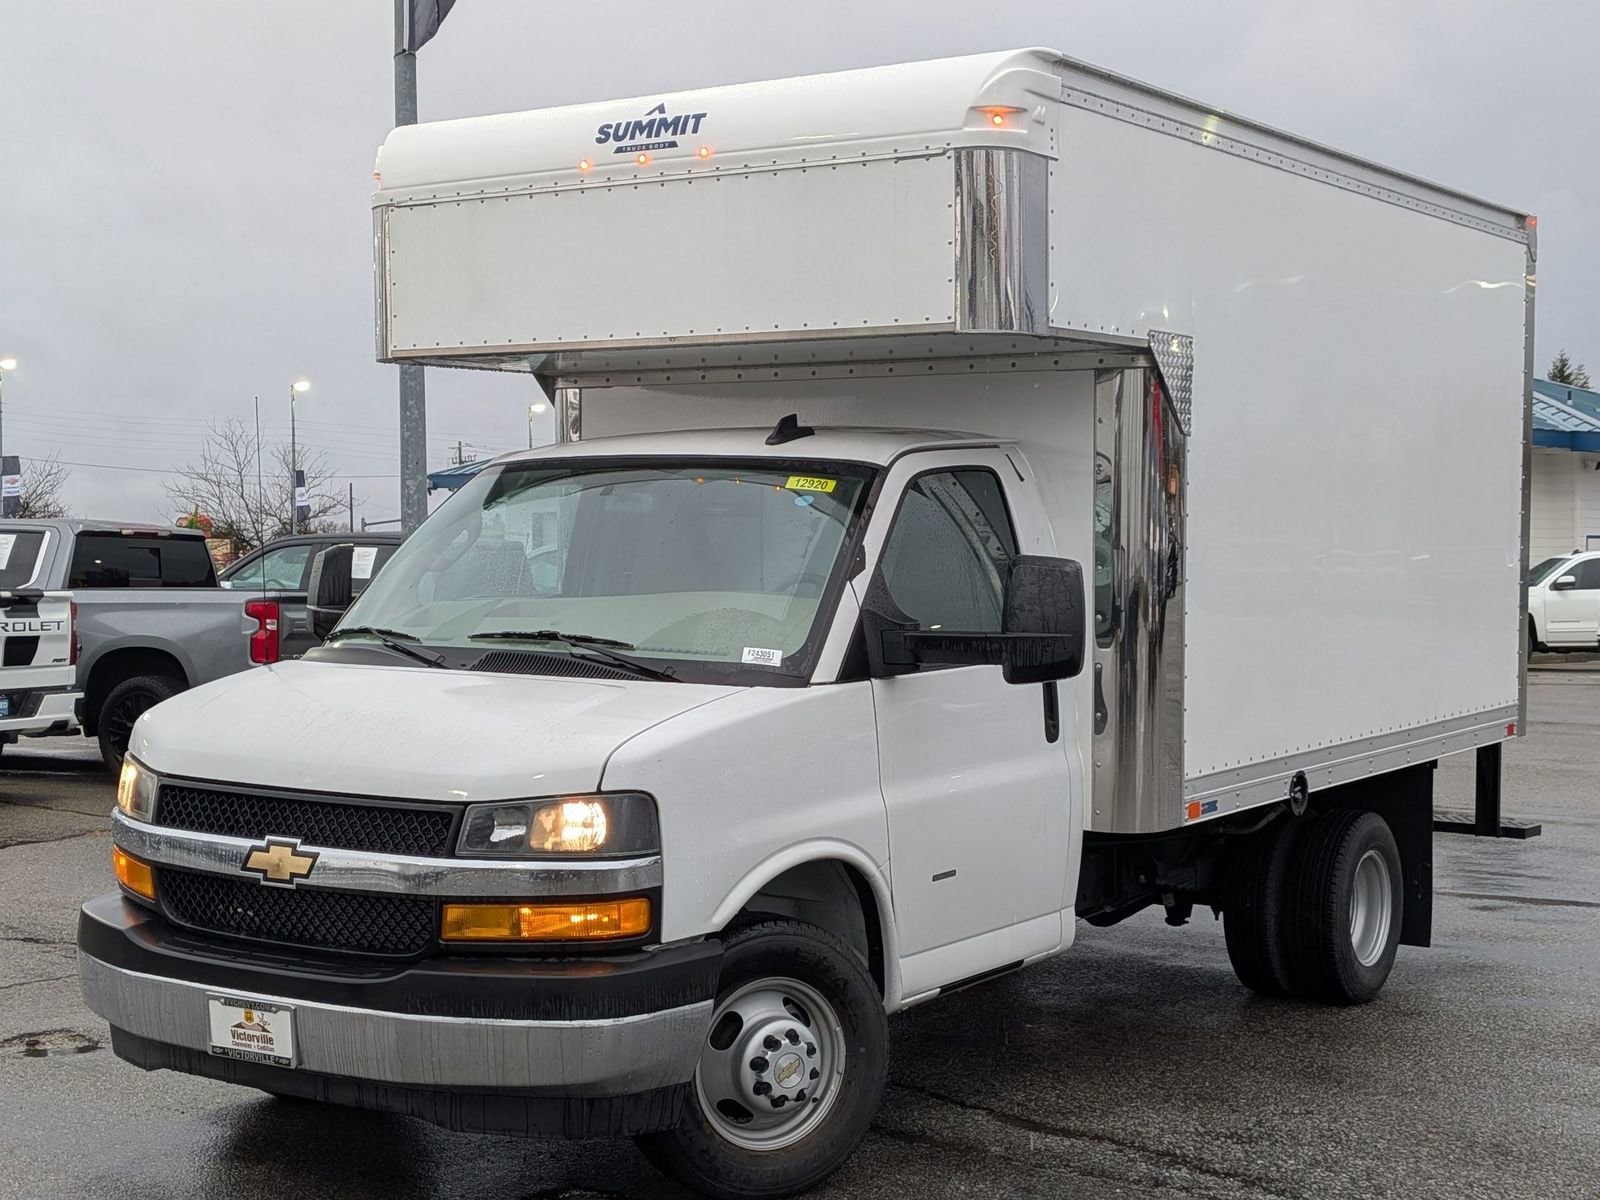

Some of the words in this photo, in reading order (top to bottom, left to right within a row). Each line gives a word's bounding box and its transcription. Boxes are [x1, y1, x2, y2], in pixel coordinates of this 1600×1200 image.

[595, 112, 707, 145] SUMMIT
[795, 478, 829, 490] 12920
[748, 649, 775, 659] F243051
[230, 1029, 274, 1046] Victorville
